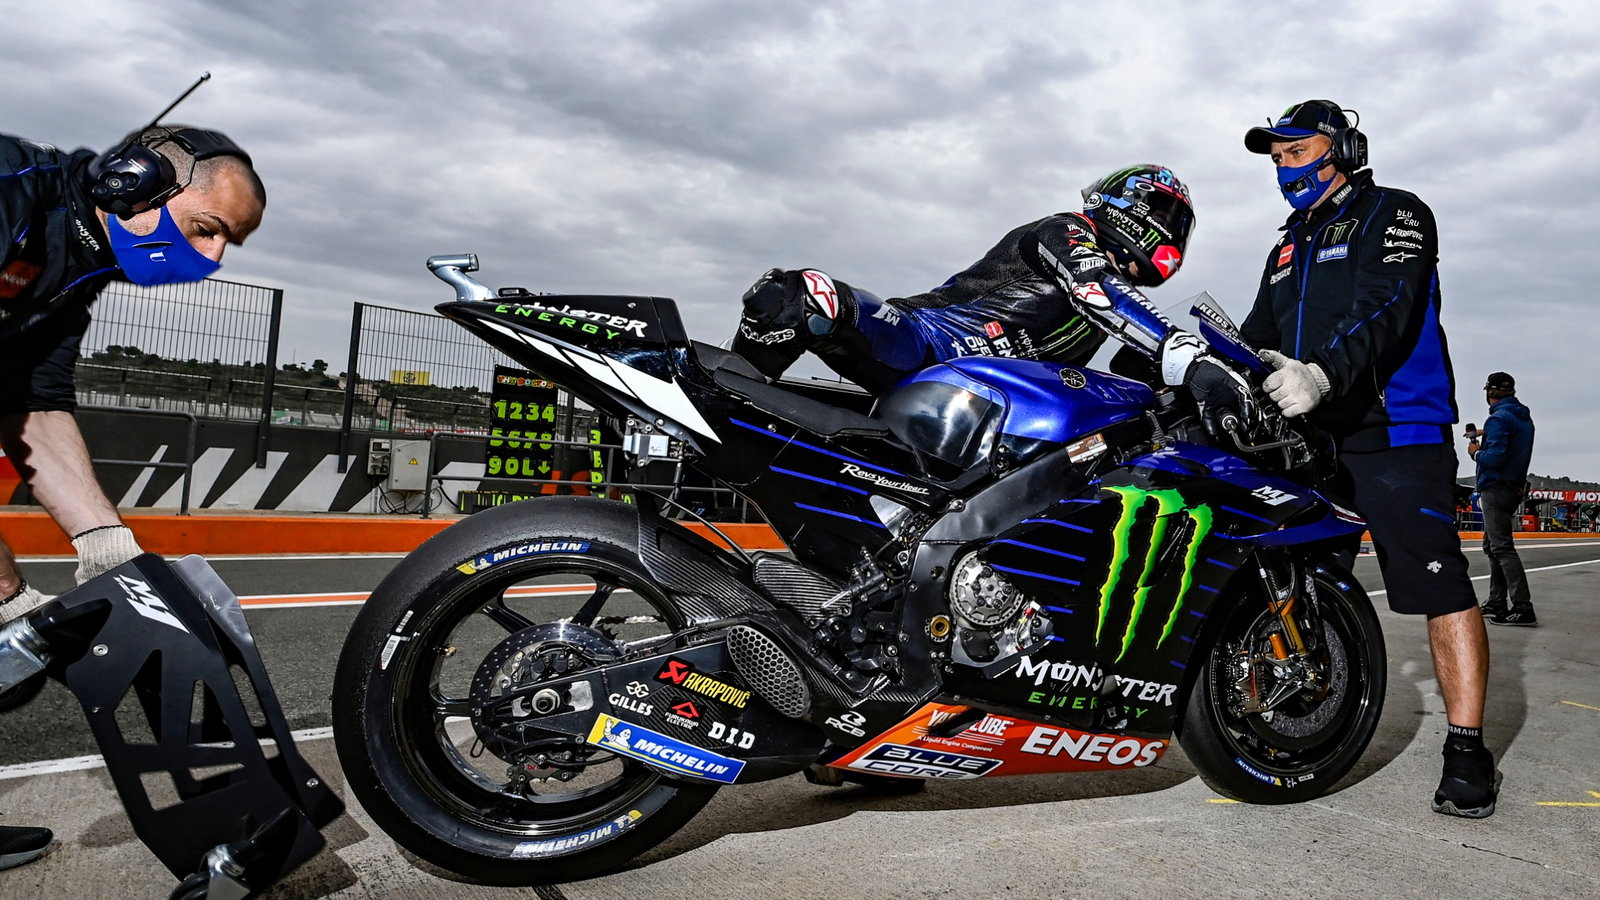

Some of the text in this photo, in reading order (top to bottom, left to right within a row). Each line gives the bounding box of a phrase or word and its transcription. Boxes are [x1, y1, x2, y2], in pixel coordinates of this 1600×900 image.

[1105, 206, 1145, 236] MONSTER
[75, 217, 101, 251] ONSTER
[1326, 246, 1348, 257] YAMAHA
[1109, 277, 1175, 328] YAMAHA
[495, 304, 620, 340] ENERGY
[497, 375, 516, 386] THE
[1251, 485, 1300, 506] M1
[493, 541, 583, 562] MICHELIN
[608, 692, 654, 717] GILLES
[666, 717, 693, 730] ELECTRIC
[825, 717, 866, 738] RCB
[1449, 725, 1479, 737] AMAHA
[708, 721, 756, 749] D.I.D
[923, 736, 941, 744] Liquid
[941, 739, 961, 748] Engine
[961, 742, 993, 753] Component
[633, 738, 729, 775] MICHELIN
[1019, 726, 1165, 767] ENEOS
[883, 747, 987, 770] BLUE
[865, 761, 968, 778] CORE
[1238, 760, 1270, 781] MICHELIN
